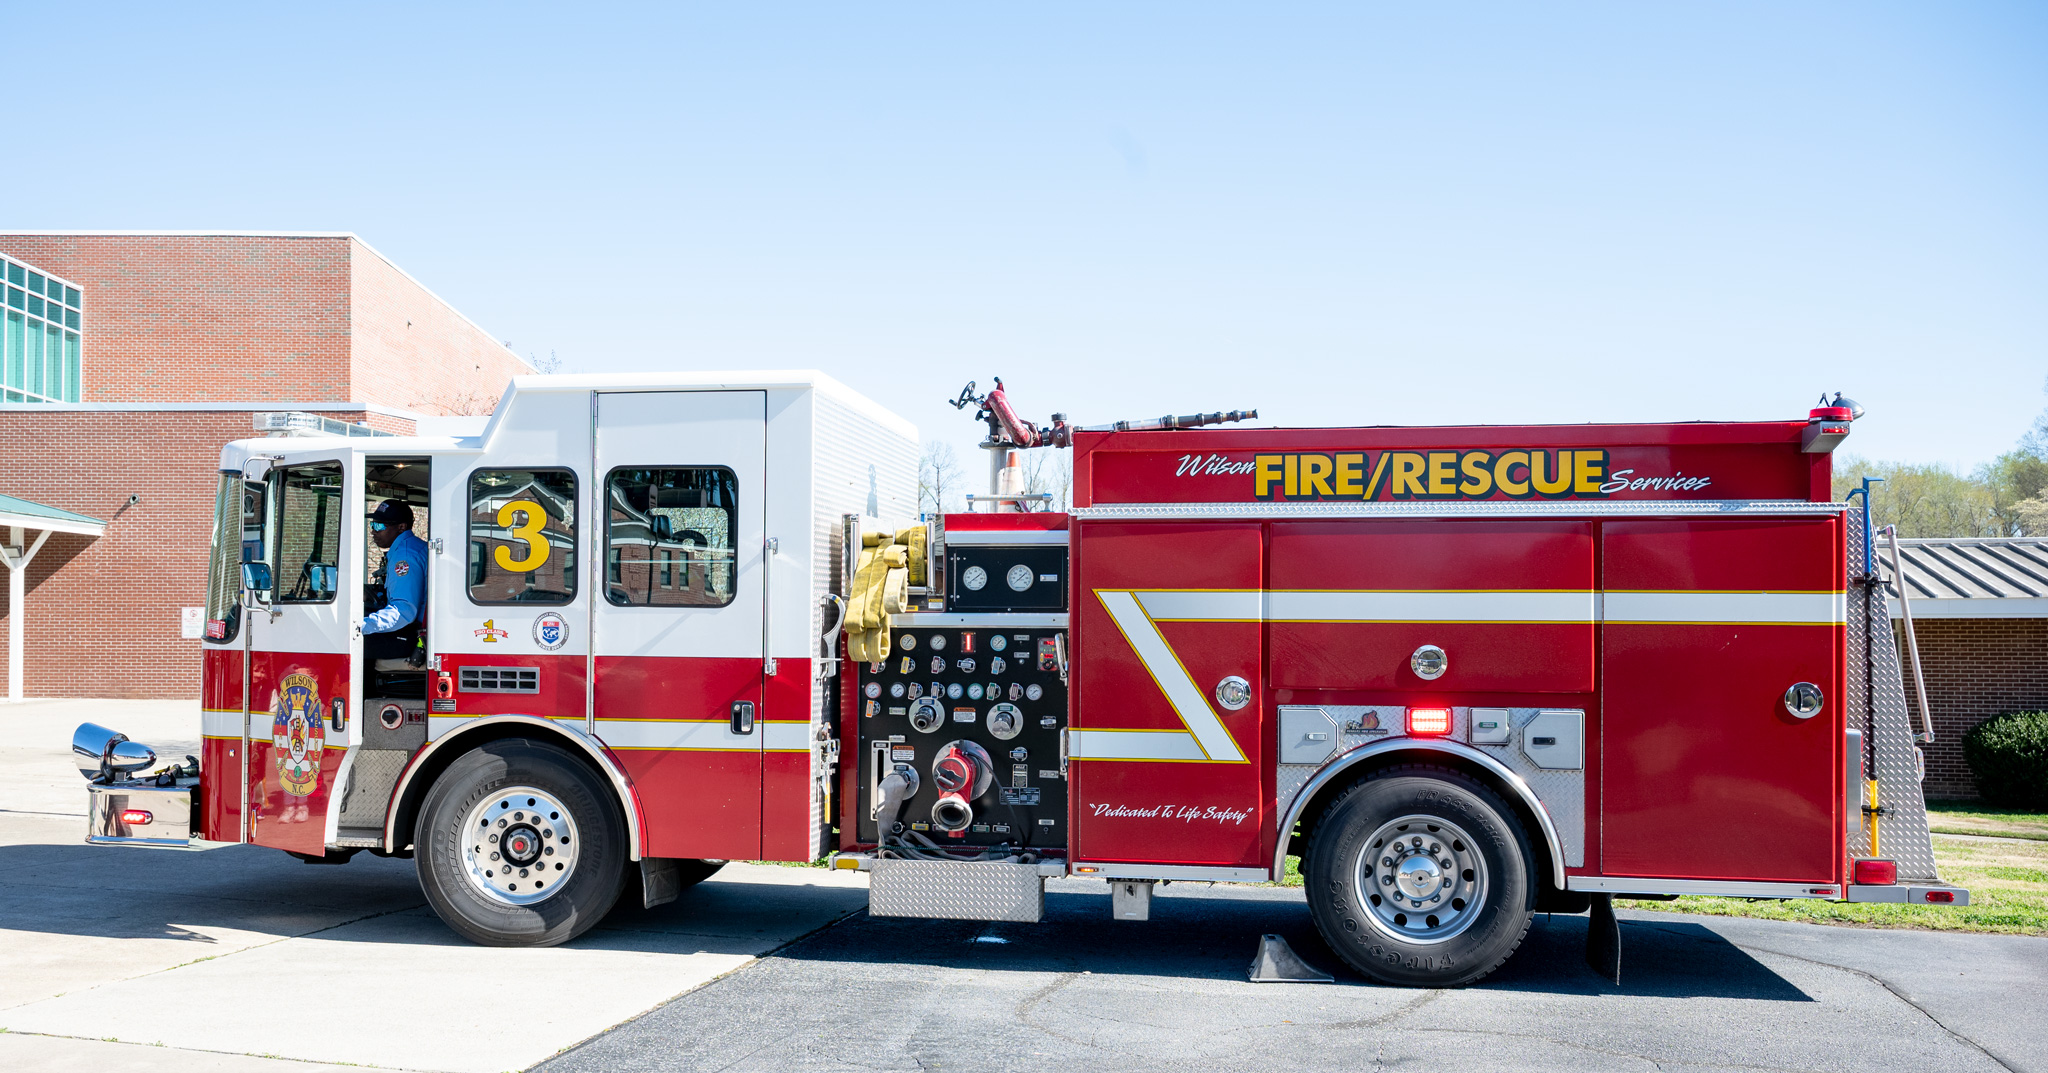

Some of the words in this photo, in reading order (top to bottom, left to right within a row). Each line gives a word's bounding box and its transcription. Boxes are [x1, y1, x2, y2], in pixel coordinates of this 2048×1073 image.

[1175, 453, 1258, 478] Wilson
[1254, 450, 1608, 498] FIRE/RESCUE
[1598, 469, 1712, 494] Services
[494, 500, 551, 573] 3
[483, 619, 497, 643] 1
[285, 675, 313, 690] WILSON
[292, 783, 306, 795] N.C.
[1161, 804, 1176, 819] To
[1176, 805, 1202, 823] Life
